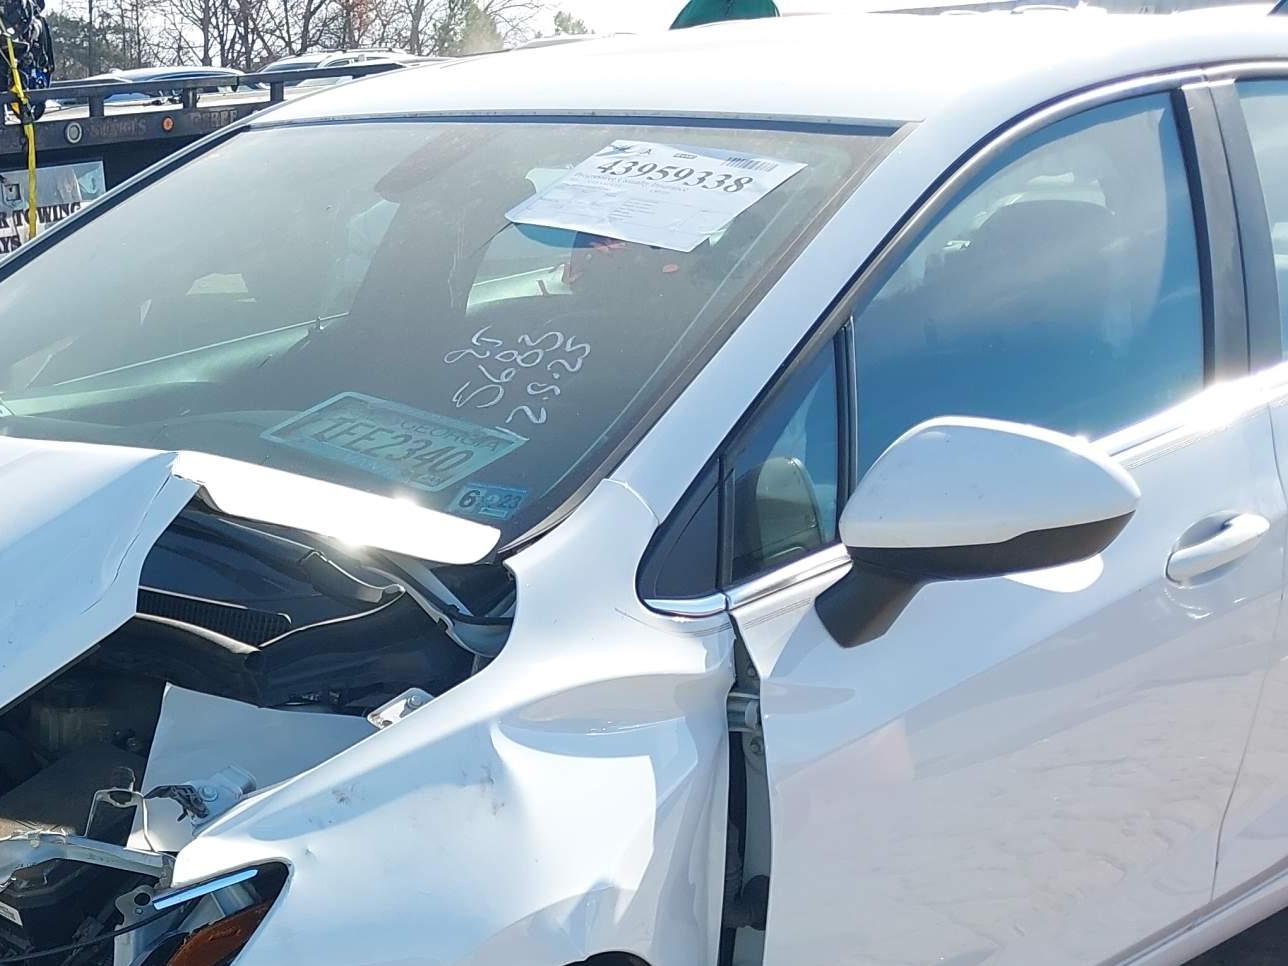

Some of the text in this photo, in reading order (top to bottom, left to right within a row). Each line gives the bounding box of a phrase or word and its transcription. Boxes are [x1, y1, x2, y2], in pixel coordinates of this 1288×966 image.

[596, 159, 754, 193] 43959338
[400, 421, 500, 452] GEORGIA
[459, 489, 481, 508] 6
